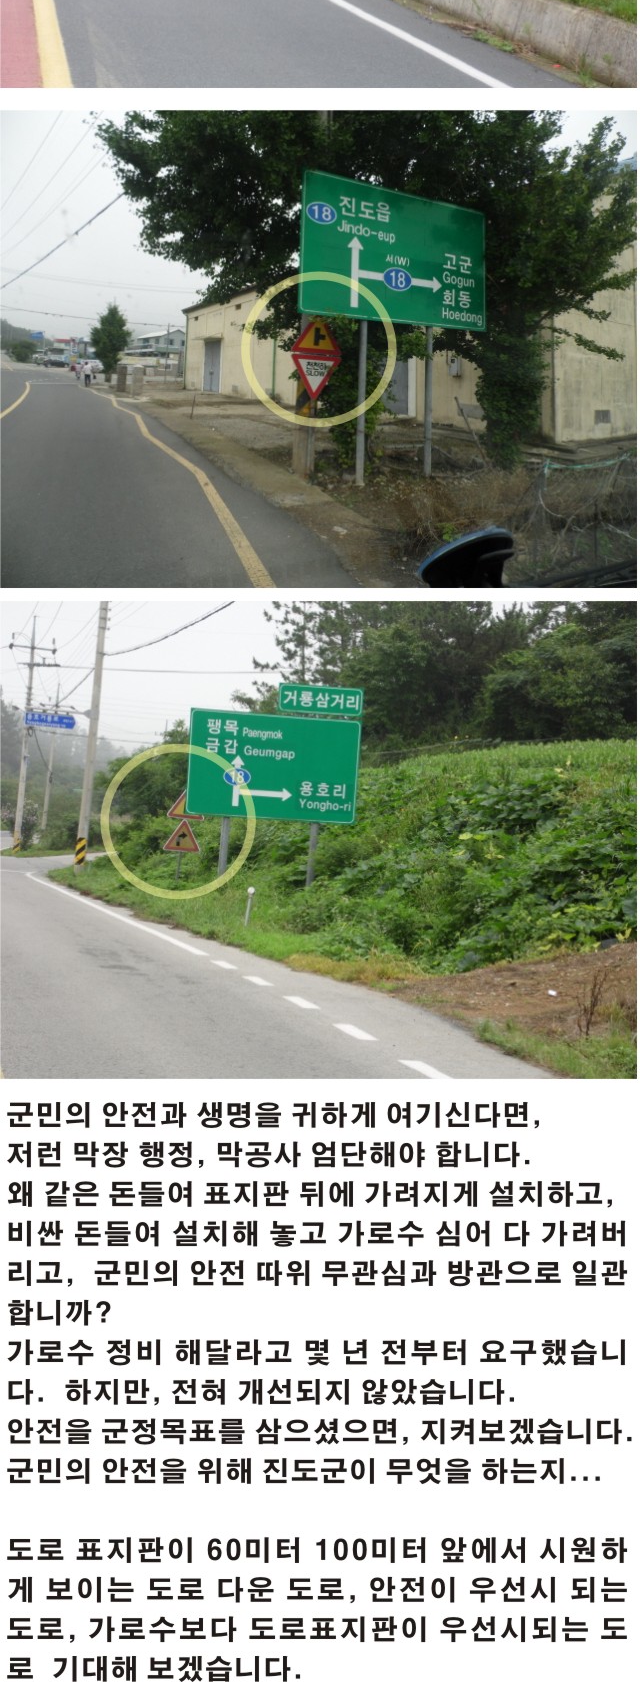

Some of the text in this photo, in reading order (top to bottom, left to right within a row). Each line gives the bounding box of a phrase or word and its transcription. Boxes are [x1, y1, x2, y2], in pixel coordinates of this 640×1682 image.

[311, 205, 332, 221] 18
[339, 196, 391, 223] 진도읍
[337, 220, 396, 245] Jindo-eup
[385, 254, 410, 267] 서(W)
[442, 253, 473, 275] 고군
[389, 271, 406, 288] 18
[442, 271, 476, 289] Gogun
[442, 289, 472, 309] 회동
[442, 307, 483, 326] Hoedong
[283, 690, 360, 711] 거룡삼거리
[207, 718, 239, 736] 팽목
[242, 727, 283, 741] Paengmok
[205, 737, 238, 755] 금갑
[243, 745, 296, 761] Geumgap
[230, 771, 245, 784] 18
[299, 780, 346, 800] 용호리
[299, 798, 352, 813] Yongho-ri
